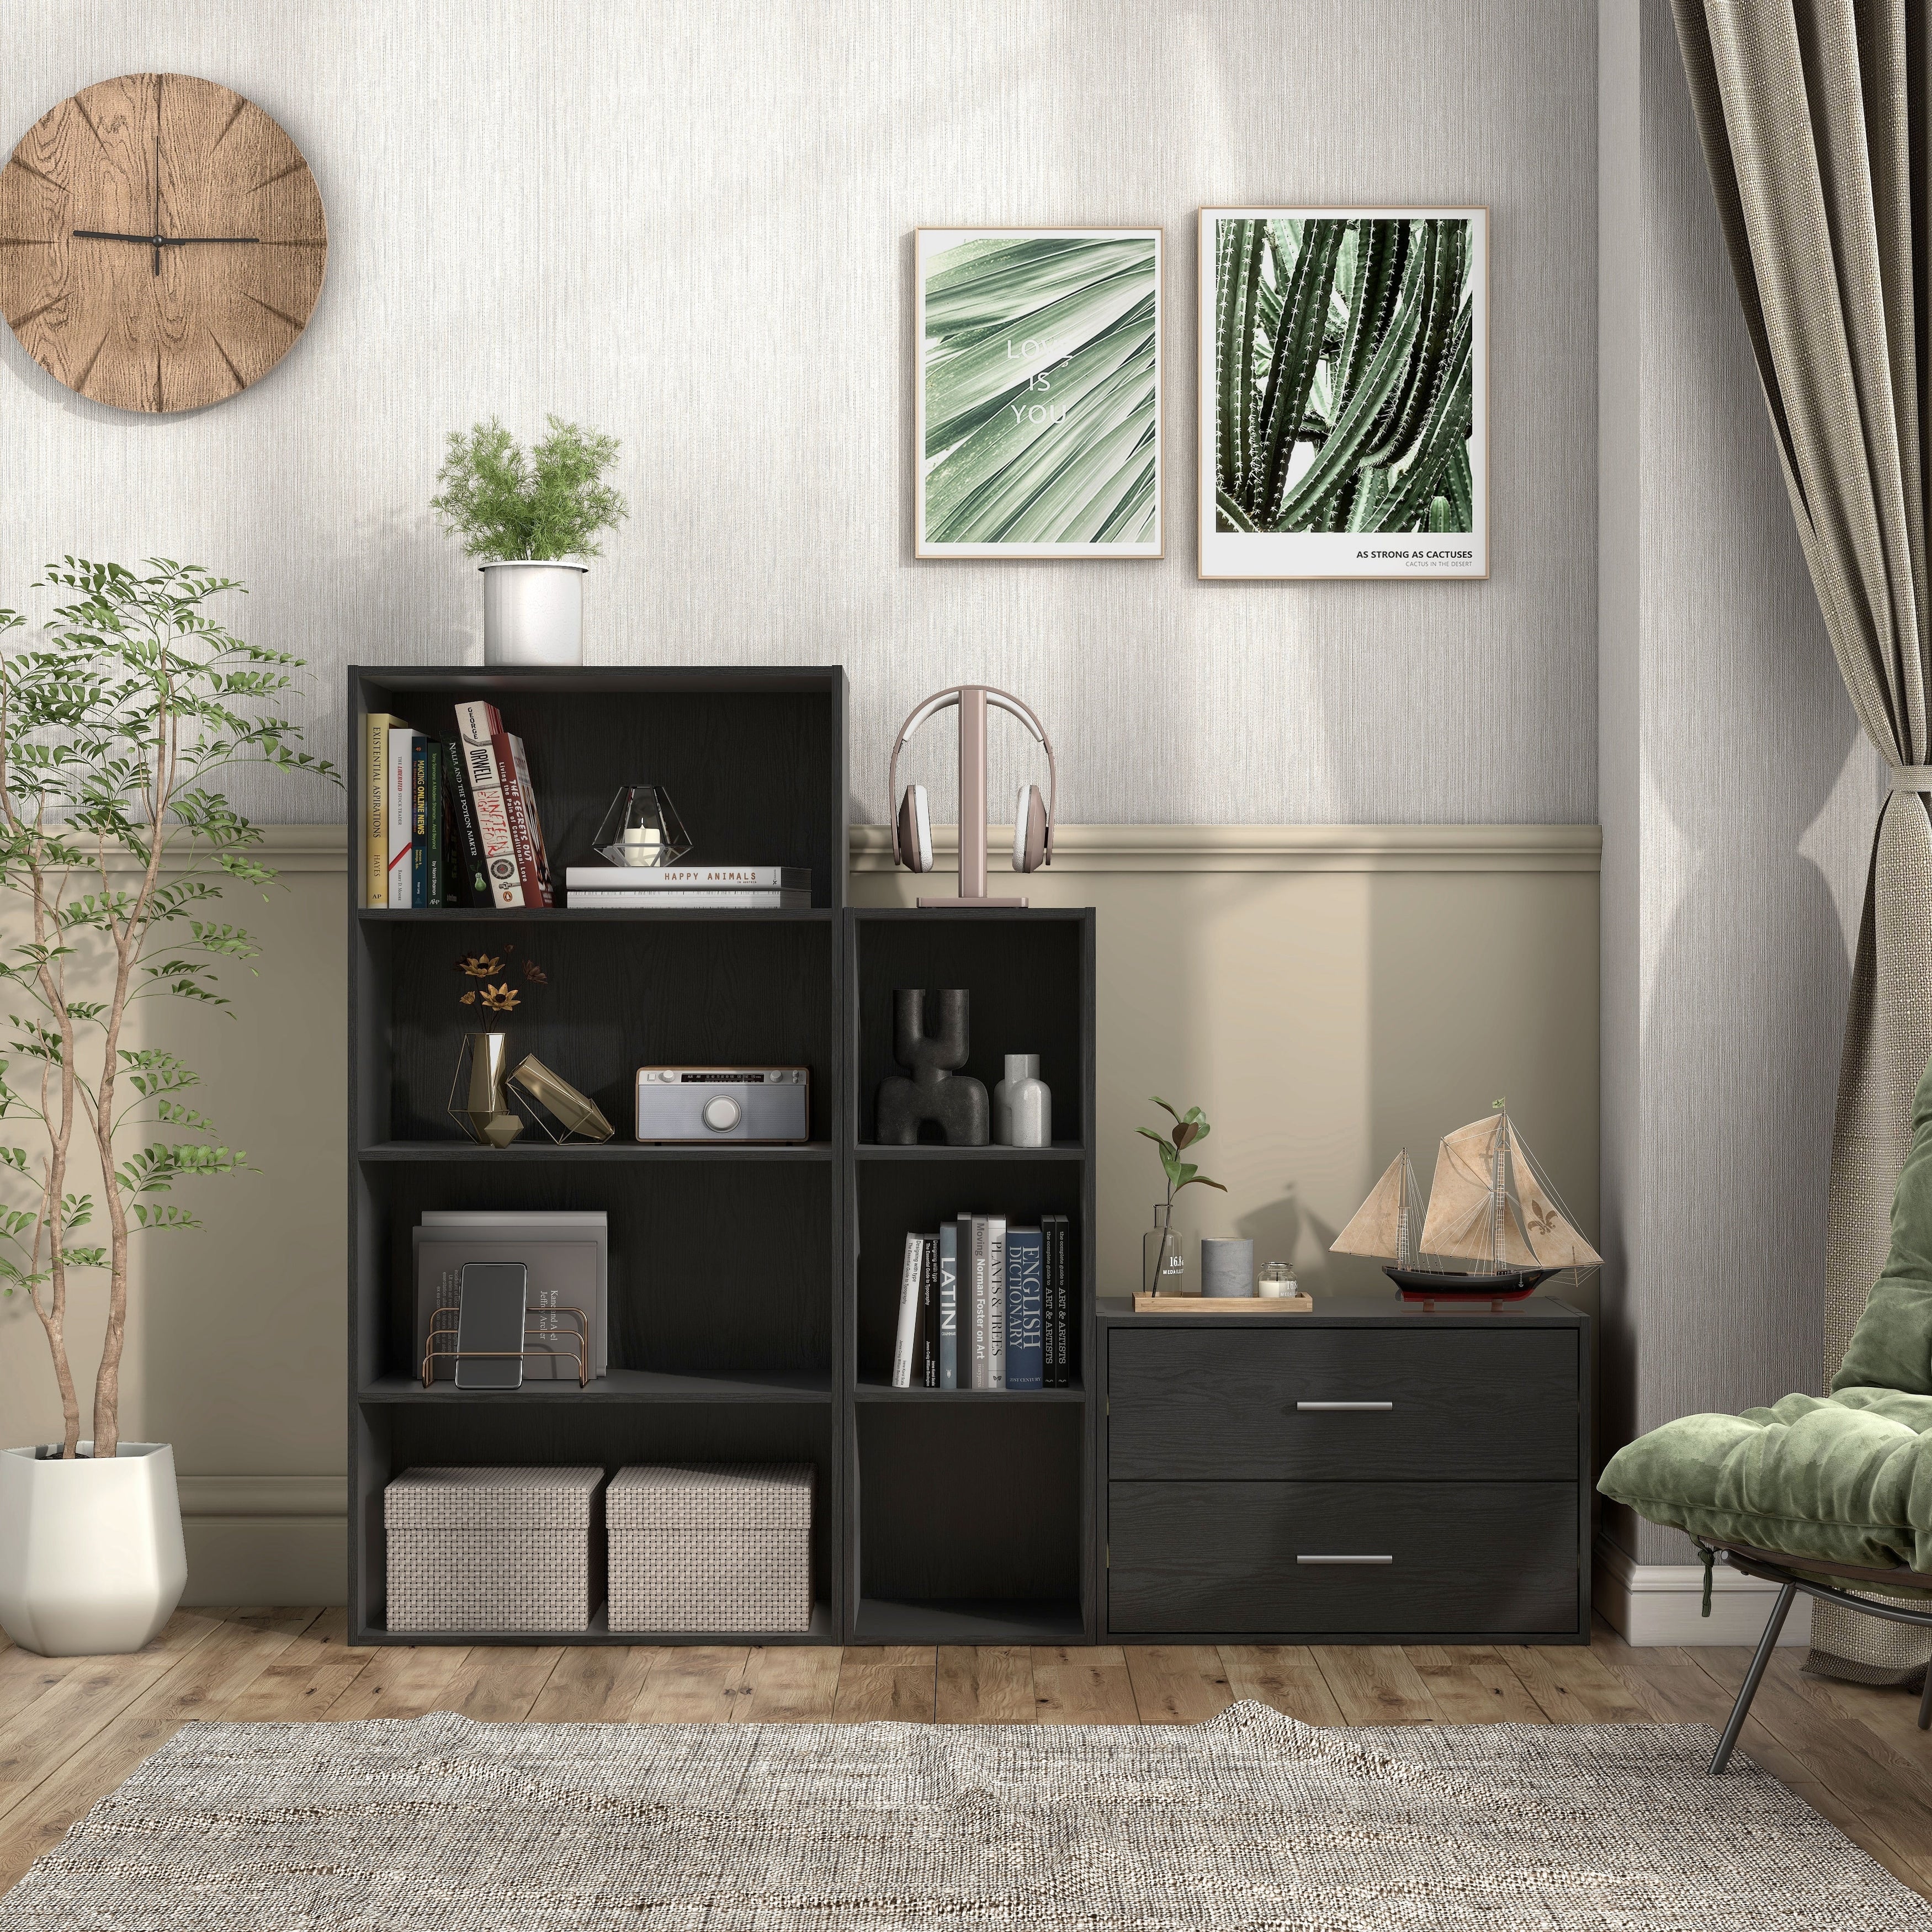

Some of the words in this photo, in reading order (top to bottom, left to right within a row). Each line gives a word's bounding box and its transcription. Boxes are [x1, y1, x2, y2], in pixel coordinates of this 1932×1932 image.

[1029, 372, 1050, 391] IS
[1011, 404, 1066, 424] YOU
[468, 707, 478, 739] GEORGE
[373, 727, 381, 782] EXISTENTIAL
[470, 749, 492, 783] ORWELL
[449, 742, 459, 766] NALIA
[460, 799, 471, 828] POTION
[467, 830, 477, 856] MAKER
[509, 779, 519, 797] THE
[373, 785, 381, 838] ASPIRATIONS
[477, 792, 498, 857] EIGHTY-FOUR
[486, 791, 509, 851] NINETEEN
[513, 800, 528, 841] SECRETS
[512, 826, 524, 864] Conditional
[523, 844, 532, 862] OUT
[975, 1223, 985, 1256] Moving
[976, 1259, 985, 1296] Norman
[991, 1241, 1002, 1294] PLANTS
[941, 1257, 956, 1329] LATIN
[991, 1298, 1002, 1307] &
[1009, 1245, 1022, 1350] DICTIONARY
[1022, 1245, 1041, 1350] ENGLISH
[976, 1298, 985, 1328] Foster
[1045, 1310, 1053, 1319] &
[1059, 1310, 1066, 1319] &
[976, 1330, 983, 1342] on
[991, 1312, 1002, 1356] TREES
[976, 1345, 985, 1359] Art
